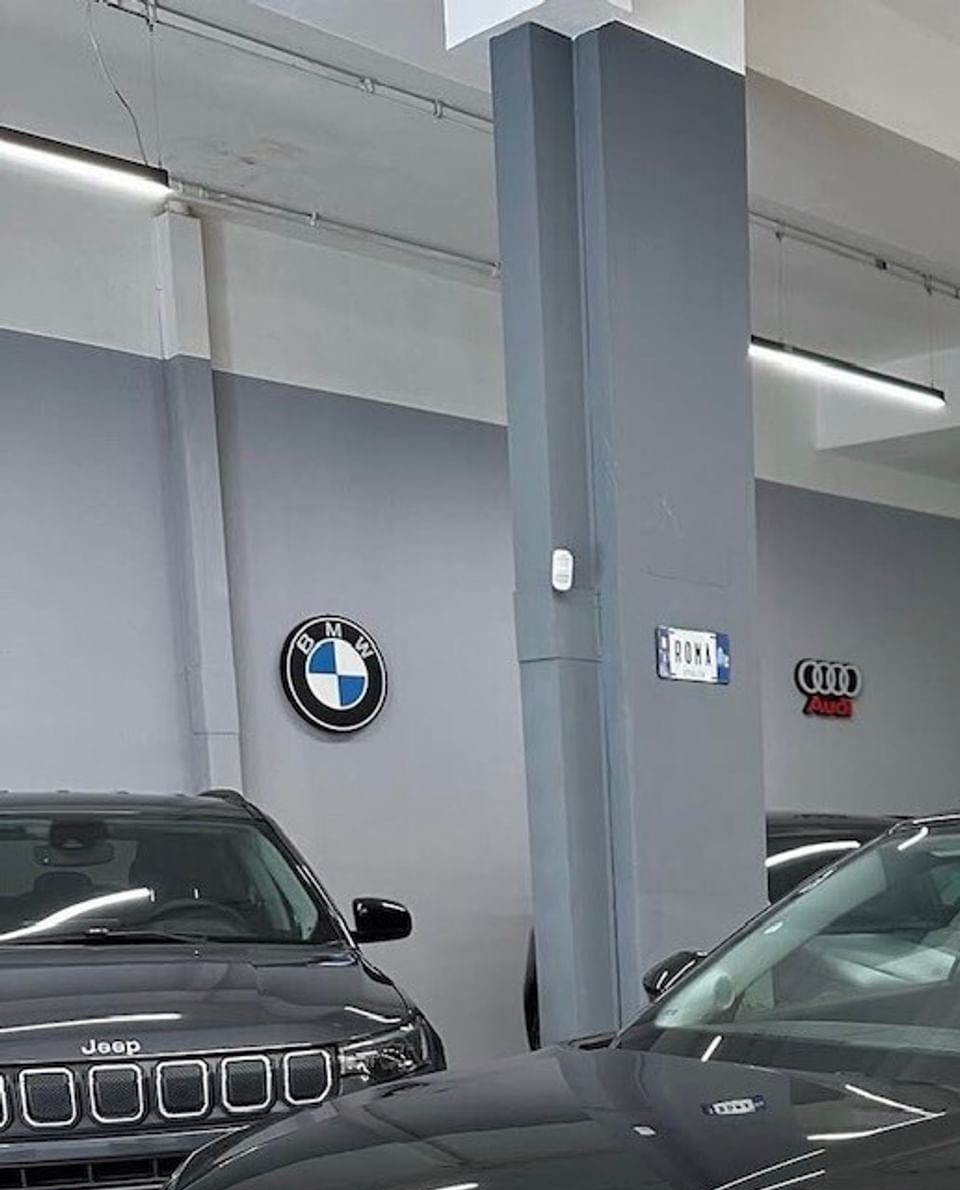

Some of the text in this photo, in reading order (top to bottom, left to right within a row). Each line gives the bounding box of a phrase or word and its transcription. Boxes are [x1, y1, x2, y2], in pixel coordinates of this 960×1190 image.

[297, 621, 374, 659] BMW
[674, 639, 712, 667] ROMA
[803, 697, 853, 717] Audi
[81, 1039, 141, 1056] Jeep
